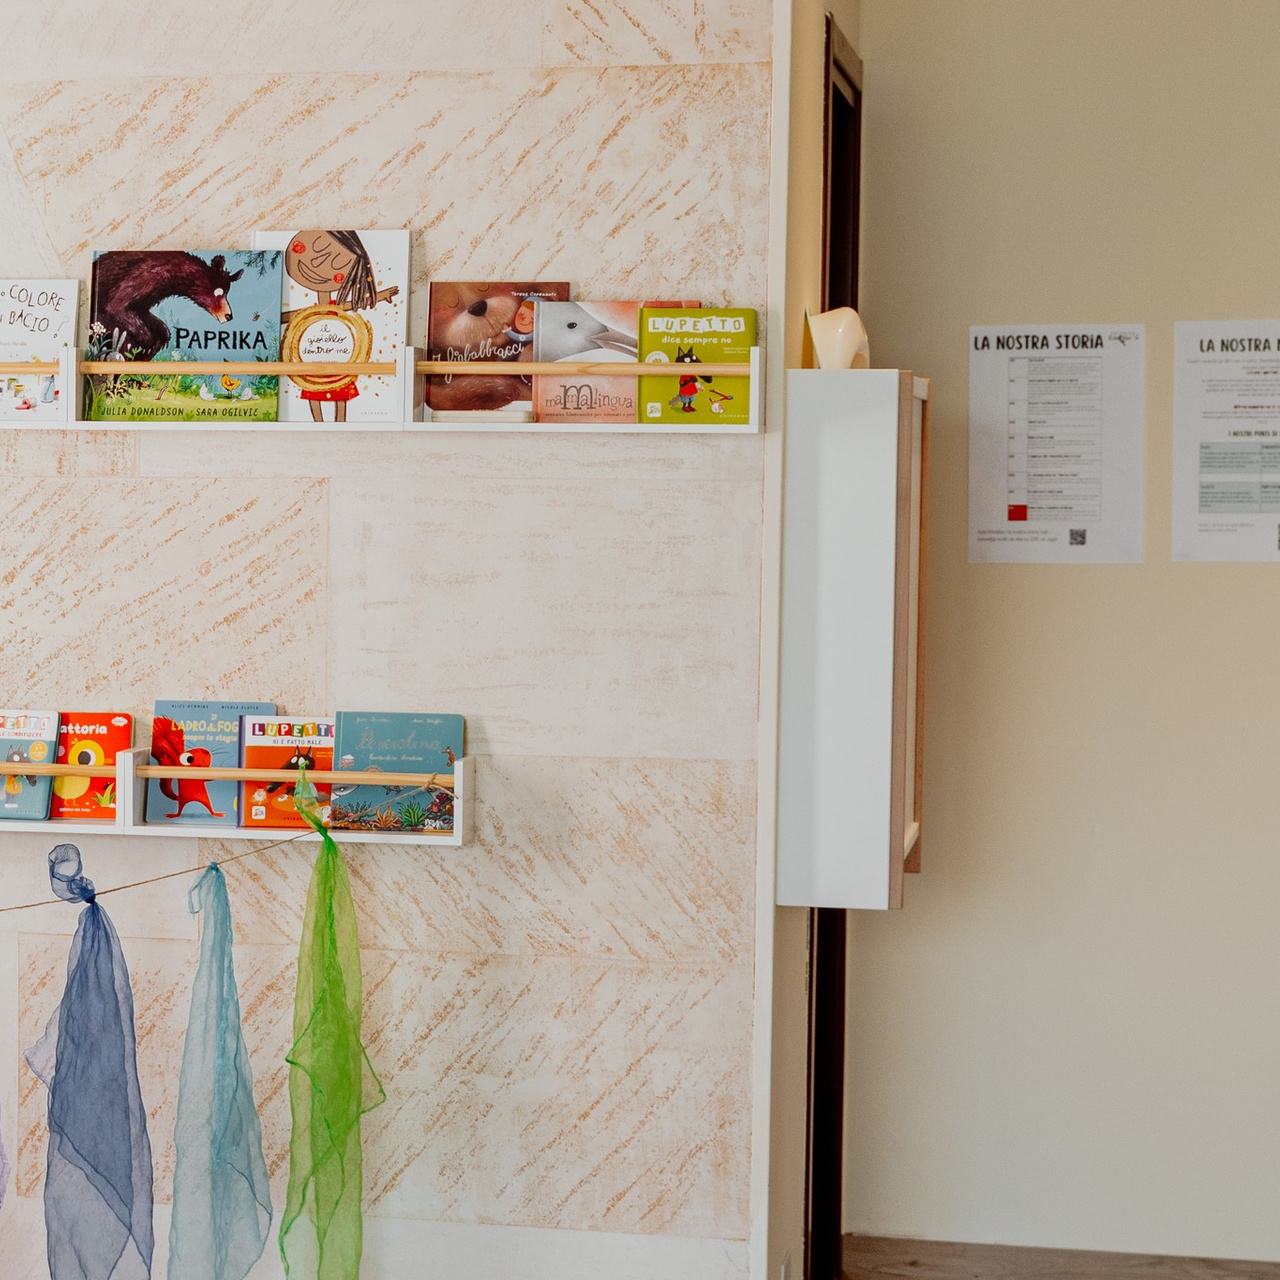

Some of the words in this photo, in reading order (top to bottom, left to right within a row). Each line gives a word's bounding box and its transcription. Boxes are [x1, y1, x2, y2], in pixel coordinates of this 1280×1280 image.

[9, 284, 66, 312] COLORE
[320, 323, 331, 333] il
[652, 319, 742, 332] LUPETTO
[175, 327, 268, 350] PAPRIKA
[662, 335, 681, 344] dice
[683, 336, 718, 346] sempre
[974, 335, 990, 351] LA
[996, 334, 1050, 351] NOSTRA
[1200, 339, 1215, 353] LA
[1220, 338, 1271, 352] NOSTRA
[101, 406, 127, 418] JULIA
[131, 406, 185, 418] DONALDSON
[195, 407, 219, 417] SARA
[221, 407, 259, 418] OGILVIE
[60, 723, 108, 734] attoria
[171, 720, 207, 732] LADRO
[217, 720, 240, 733] FOG
